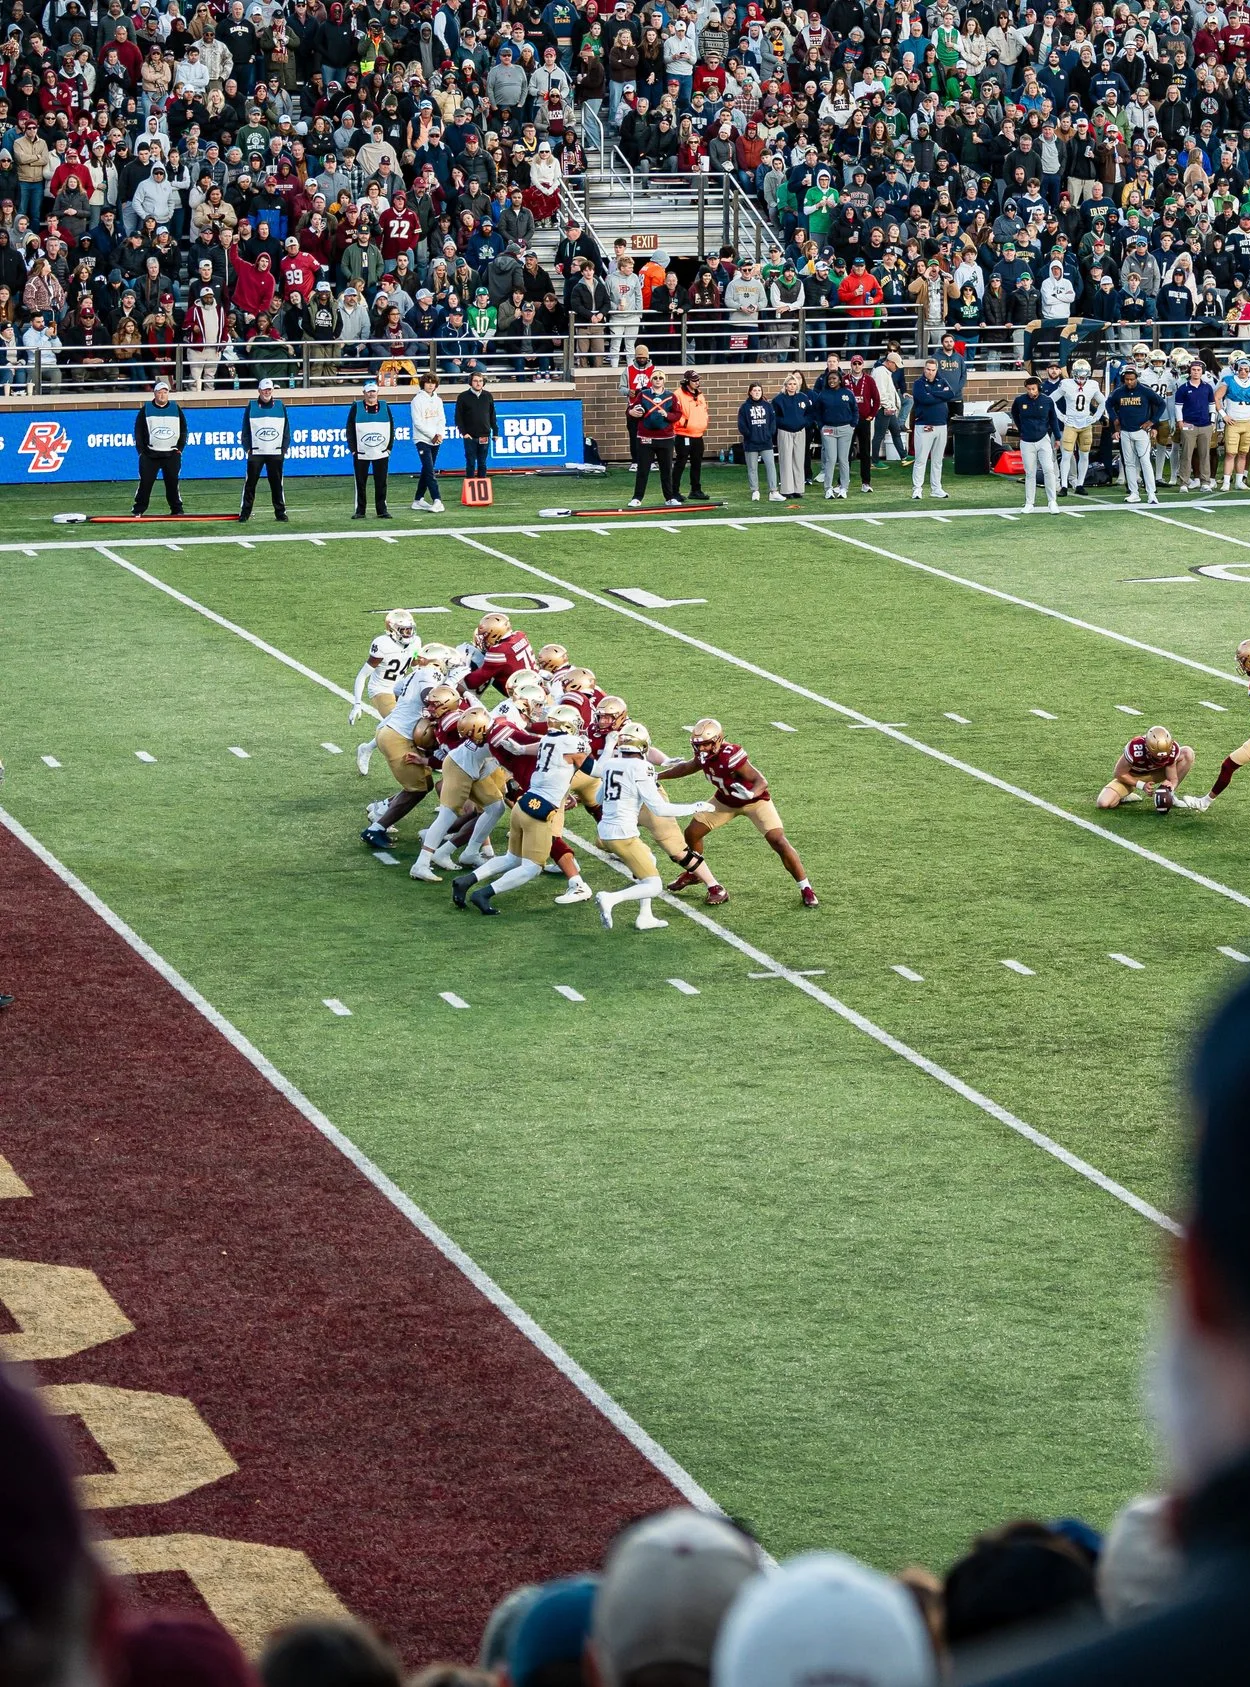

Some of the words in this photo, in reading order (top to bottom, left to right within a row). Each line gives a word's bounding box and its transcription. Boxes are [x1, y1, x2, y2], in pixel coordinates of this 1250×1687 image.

[389, 219, 410, 238] 22
[636, 235, 655, 249] EXIT
[285, 269, 304, 285] 99
[476, 316, 489, 334] 10
[1075, 394, 1085, 411] 0
[504, 418, 552, 436] BUD
[87, 433, 138, 448] OFFICIA
[205, 431, 234, 445] BEER
[294, 430, 309, 442] OF
[311, 429, 347, 443] BOSTO
[495, 436, 562, 454] LIGHT
[284, 445, 329, 459] ONSIBLY
[468, 480, 488, 502] 10
[451, 586, 708, 614] 10
[1133, 743, 1144, 757] 28
[604, 769, 624, 801] 15
